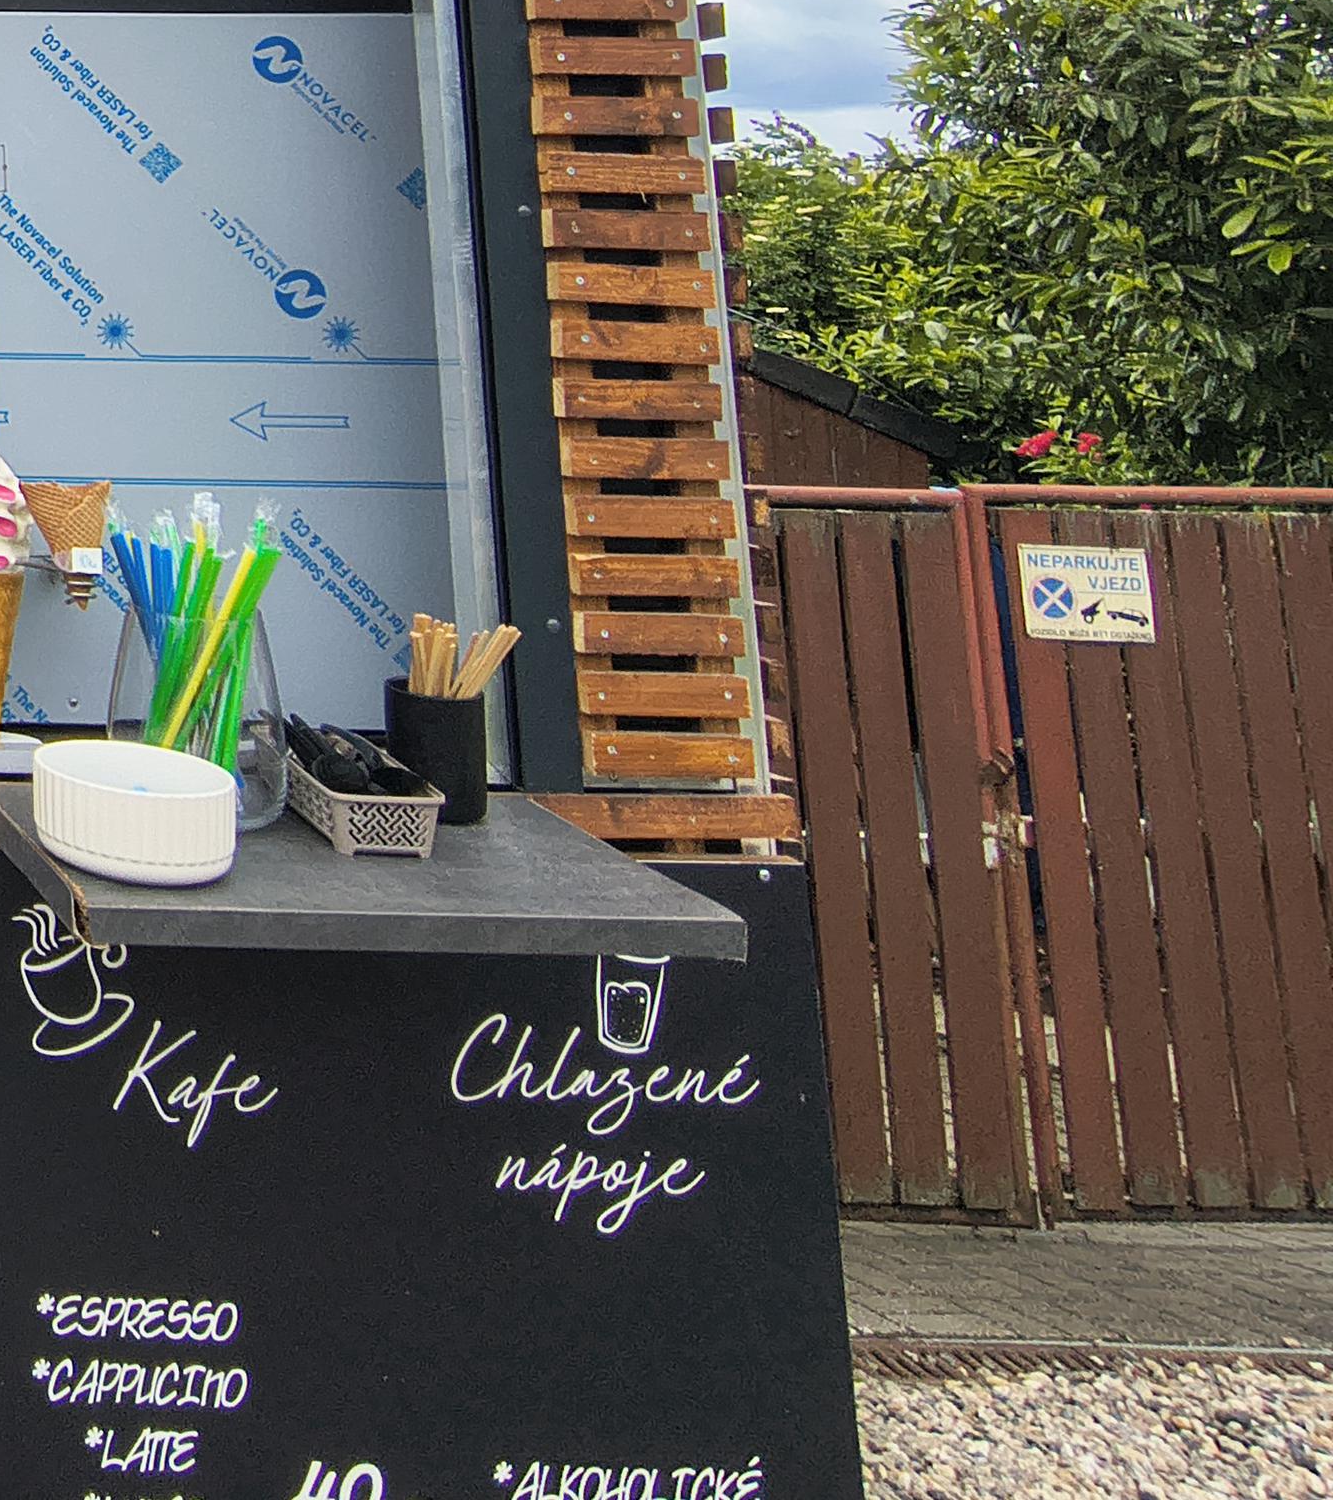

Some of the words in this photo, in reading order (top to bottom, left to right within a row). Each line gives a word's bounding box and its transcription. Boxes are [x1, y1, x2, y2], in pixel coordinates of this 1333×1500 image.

[29, 45, 75, 93] Solution
[59, 48, 72, 62] &
[69, 59, 101, 89] Fiber
[70, 89, 118, 134] Novacel
[96, 84, 137, 124] LASER
[115, 130, 138, 155] The
[134, 120, 154, 141] for
[16, 213, 63, 259] Novacel
[58, 256, 105, 305] Solution
[32, 258, 64, 292] Fiber
[61, 287, 75, 302] &
[279, 531, 325, 582] Solution
[308, 531, 323, 548] &
[319, 545, 354, 579] Fiber
[1027, 553, 1140, 572] NEPARKUJTE
[319, 577, 370, 628] Novacel
[347, 573, 390, 617] LASER
[1087, 575, 1142, 592] VJEZD
[368, 622, 392, 650] The
[387, 612, 407, 635] for
[112, 1019, 279, 1149] Kafe
[449, 1013, 760, 1136] Chlazené
[495, 1143, 707, 1235] nápoje
